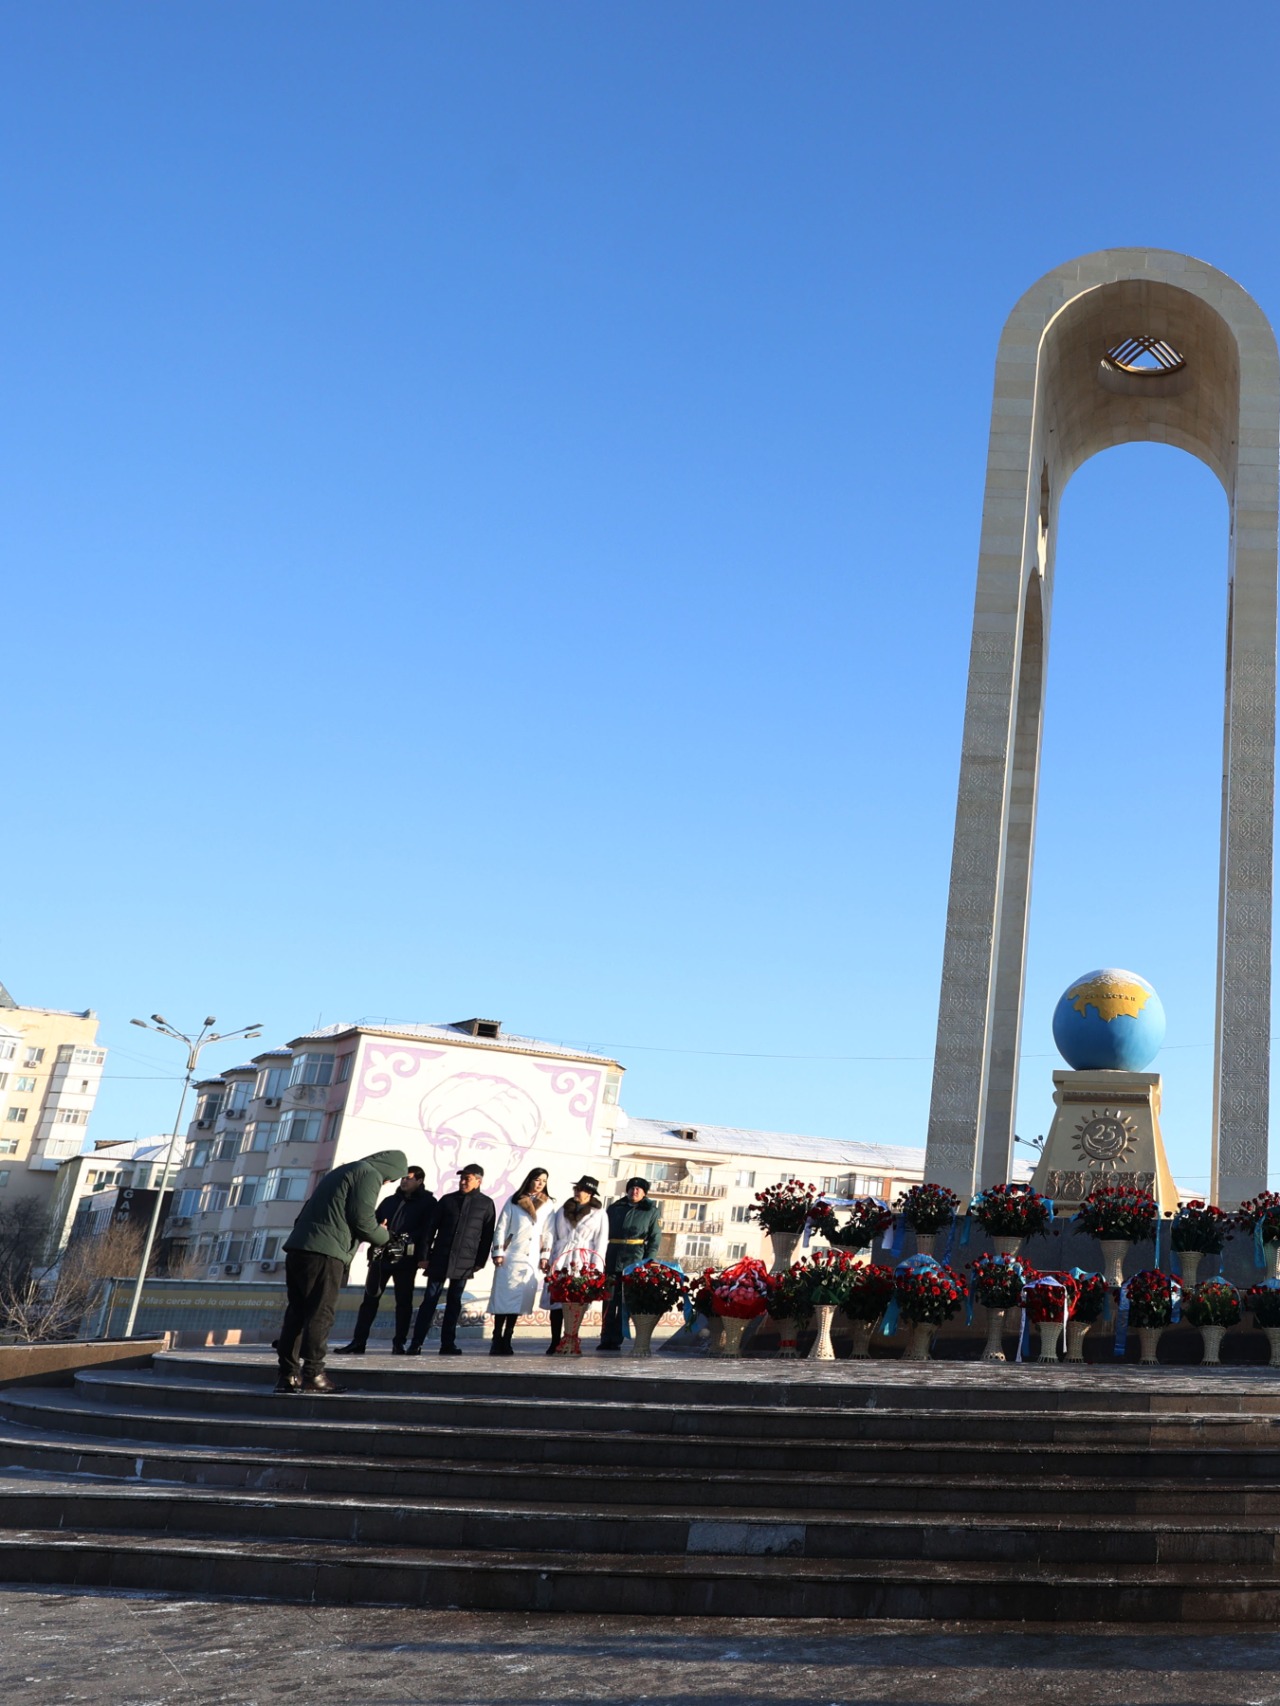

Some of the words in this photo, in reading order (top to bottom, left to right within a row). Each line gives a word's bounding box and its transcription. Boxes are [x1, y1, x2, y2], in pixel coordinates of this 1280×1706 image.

[1093, 1124, 1116, 1141] 25
[194, 1297, 206, 1305] de
[208, 1297, 217, 1306] lo
[218, 1299, 236, 1307] que
[238, 1298, 263, 1306] usted
